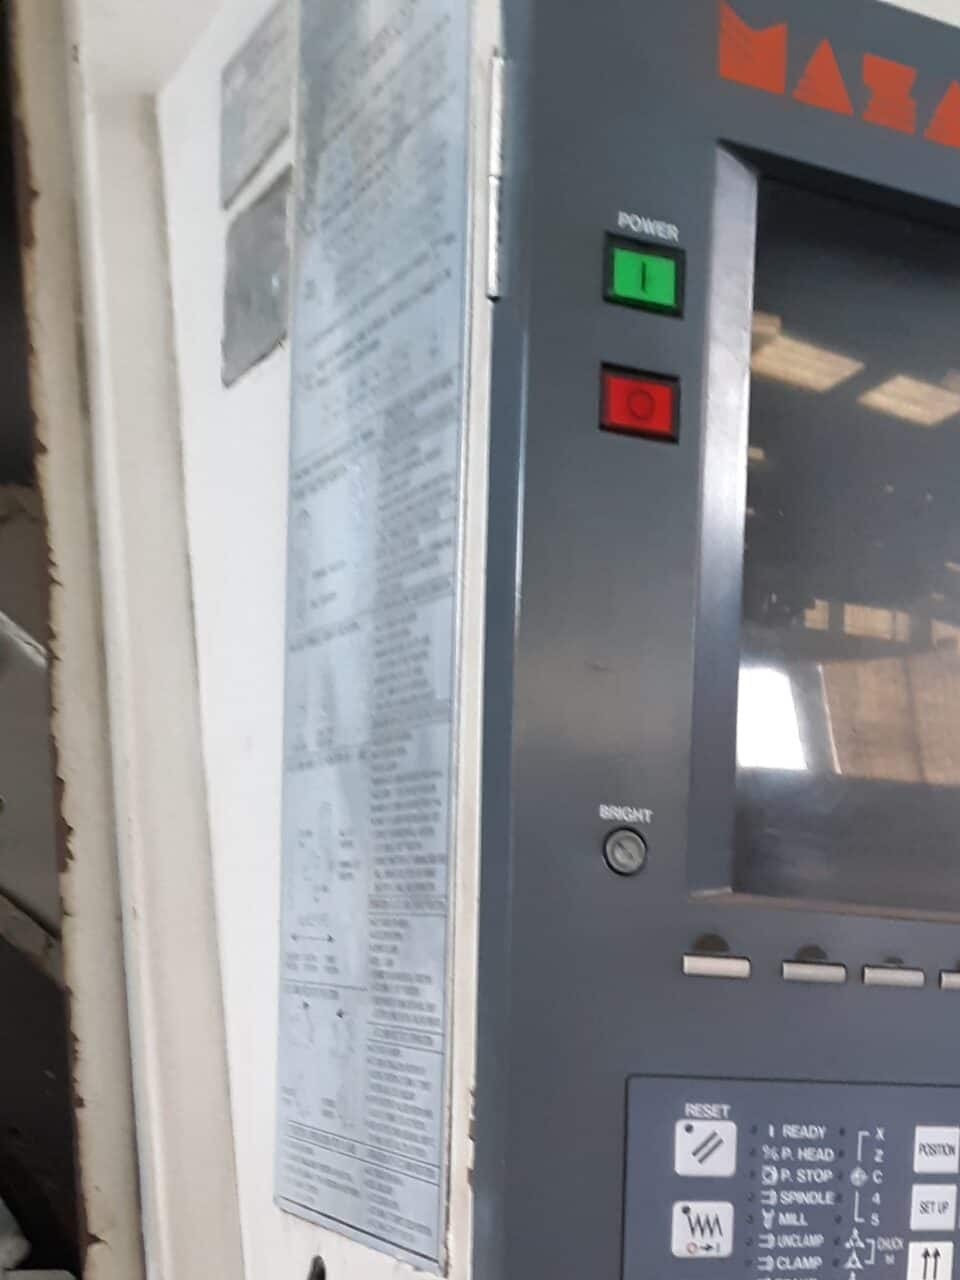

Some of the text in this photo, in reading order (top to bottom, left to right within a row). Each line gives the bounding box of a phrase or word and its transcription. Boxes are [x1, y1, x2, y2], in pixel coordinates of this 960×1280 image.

[618, 211, 679, 242] POWER
[599, 804, 653, 823] BRIGHT
[685, 1103, 731, 1119] RESET
[782, 1125, 826, 1139] READY
[798, 1149, 834, 1160] HEAD
[797, 1170, 833, 1182] STOP
[873, 1171, 882, 1183] C
[779, 1191, 835, 1205] SPINDLE
[779, 1213, 808, 1226] MILL
[777, 1234, 824, 1248] UNCLAMP
[776, 1257, 822, 1270] CLAMP
